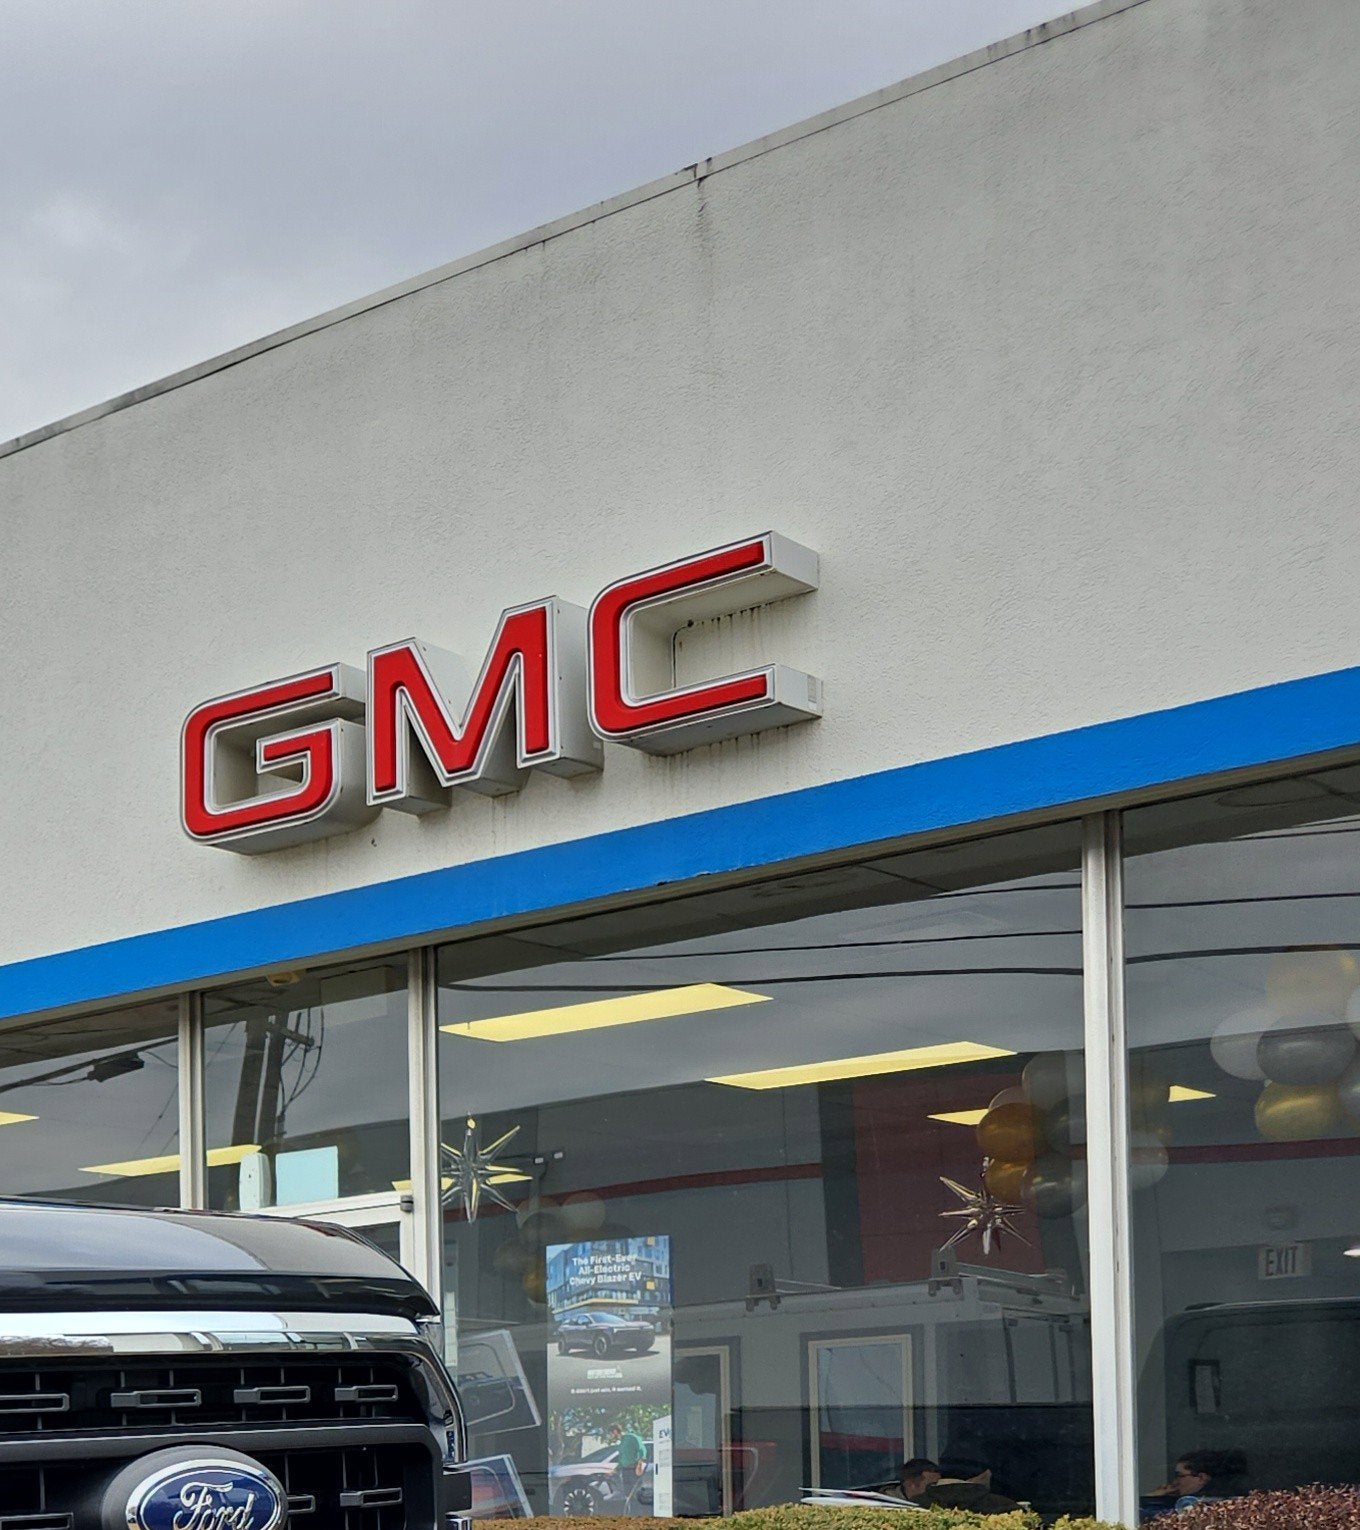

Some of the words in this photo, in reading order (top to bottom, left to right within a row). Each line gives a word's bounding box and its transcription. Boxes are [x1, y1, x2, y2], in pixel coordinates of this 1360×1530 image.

[181, 531, 822, 856] GMC
[572, 1257, 589, 1266] The
[1265, 1246, 1297, 1276] EXIT
[579, 1264, 631, 1275] All-Electric
[569, 1276, 596, 1286] Chevy
[597, 1273, 627, 1283] Blazer
[628, 1271, 642, 1281] EV
